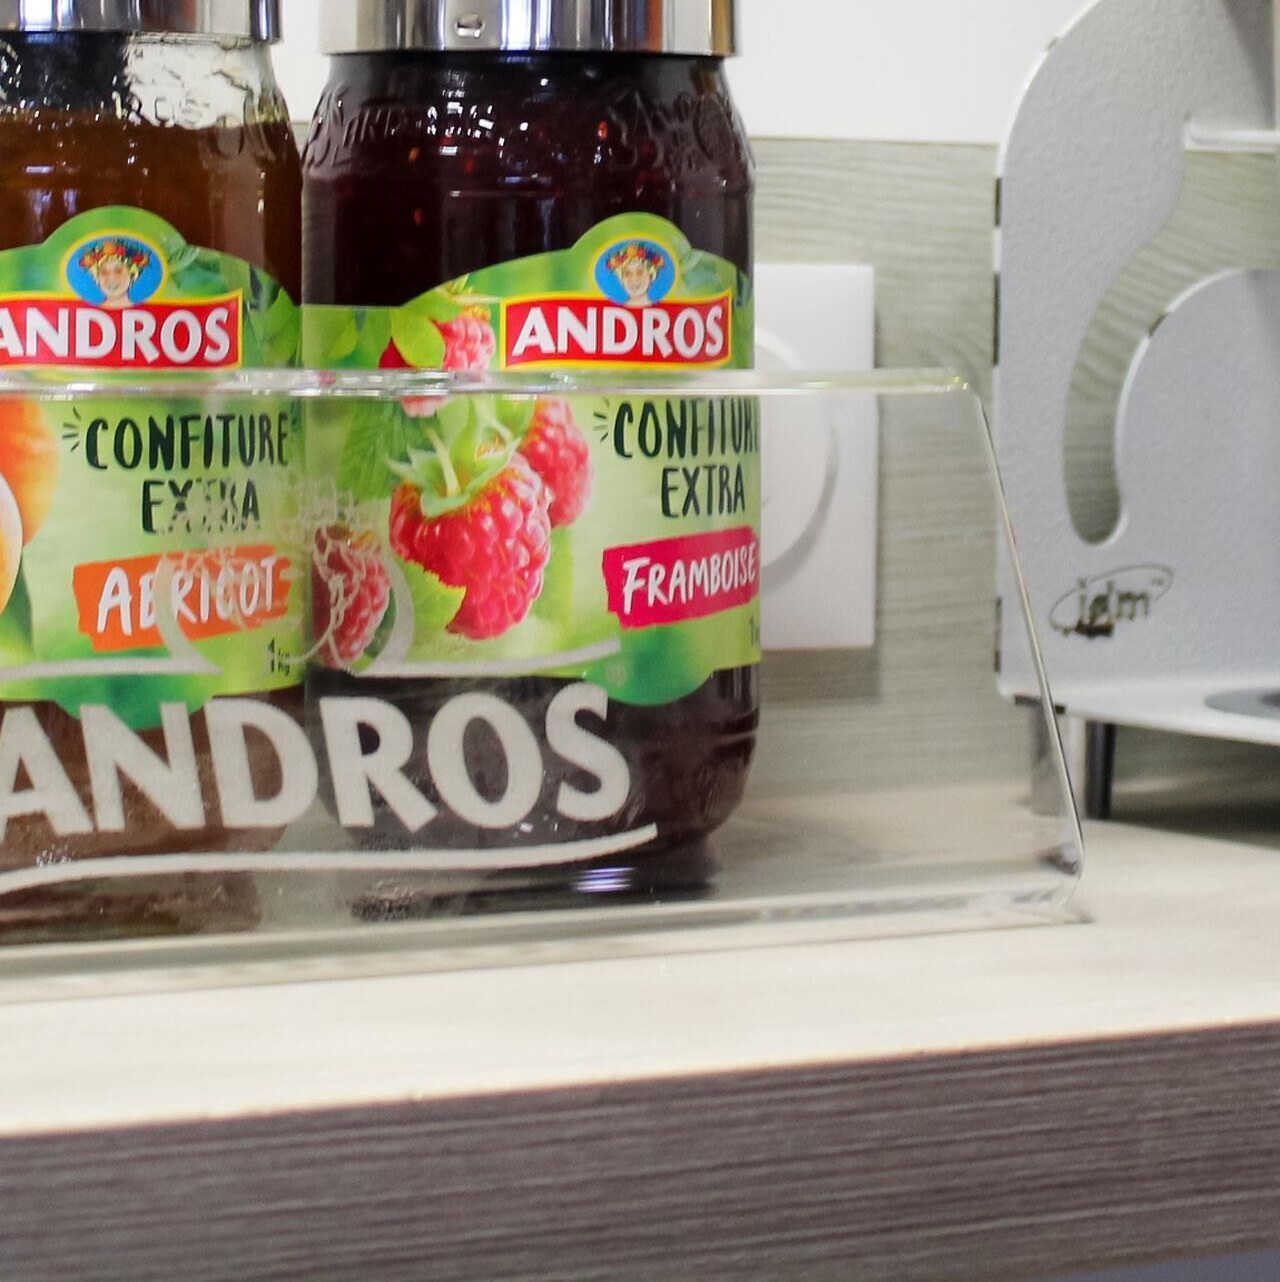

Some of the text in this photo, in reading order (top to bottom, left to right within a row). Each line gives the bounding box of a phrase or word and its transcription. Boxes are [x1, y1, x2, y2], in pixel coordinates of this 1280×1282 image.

[512, 304, 725, 359] ANDROS
[86, 411, 289, 470] CONFITURE
[661, 463, 745, 519] EXTRA
[622, 542, 757, 615] FRAMBOISE
